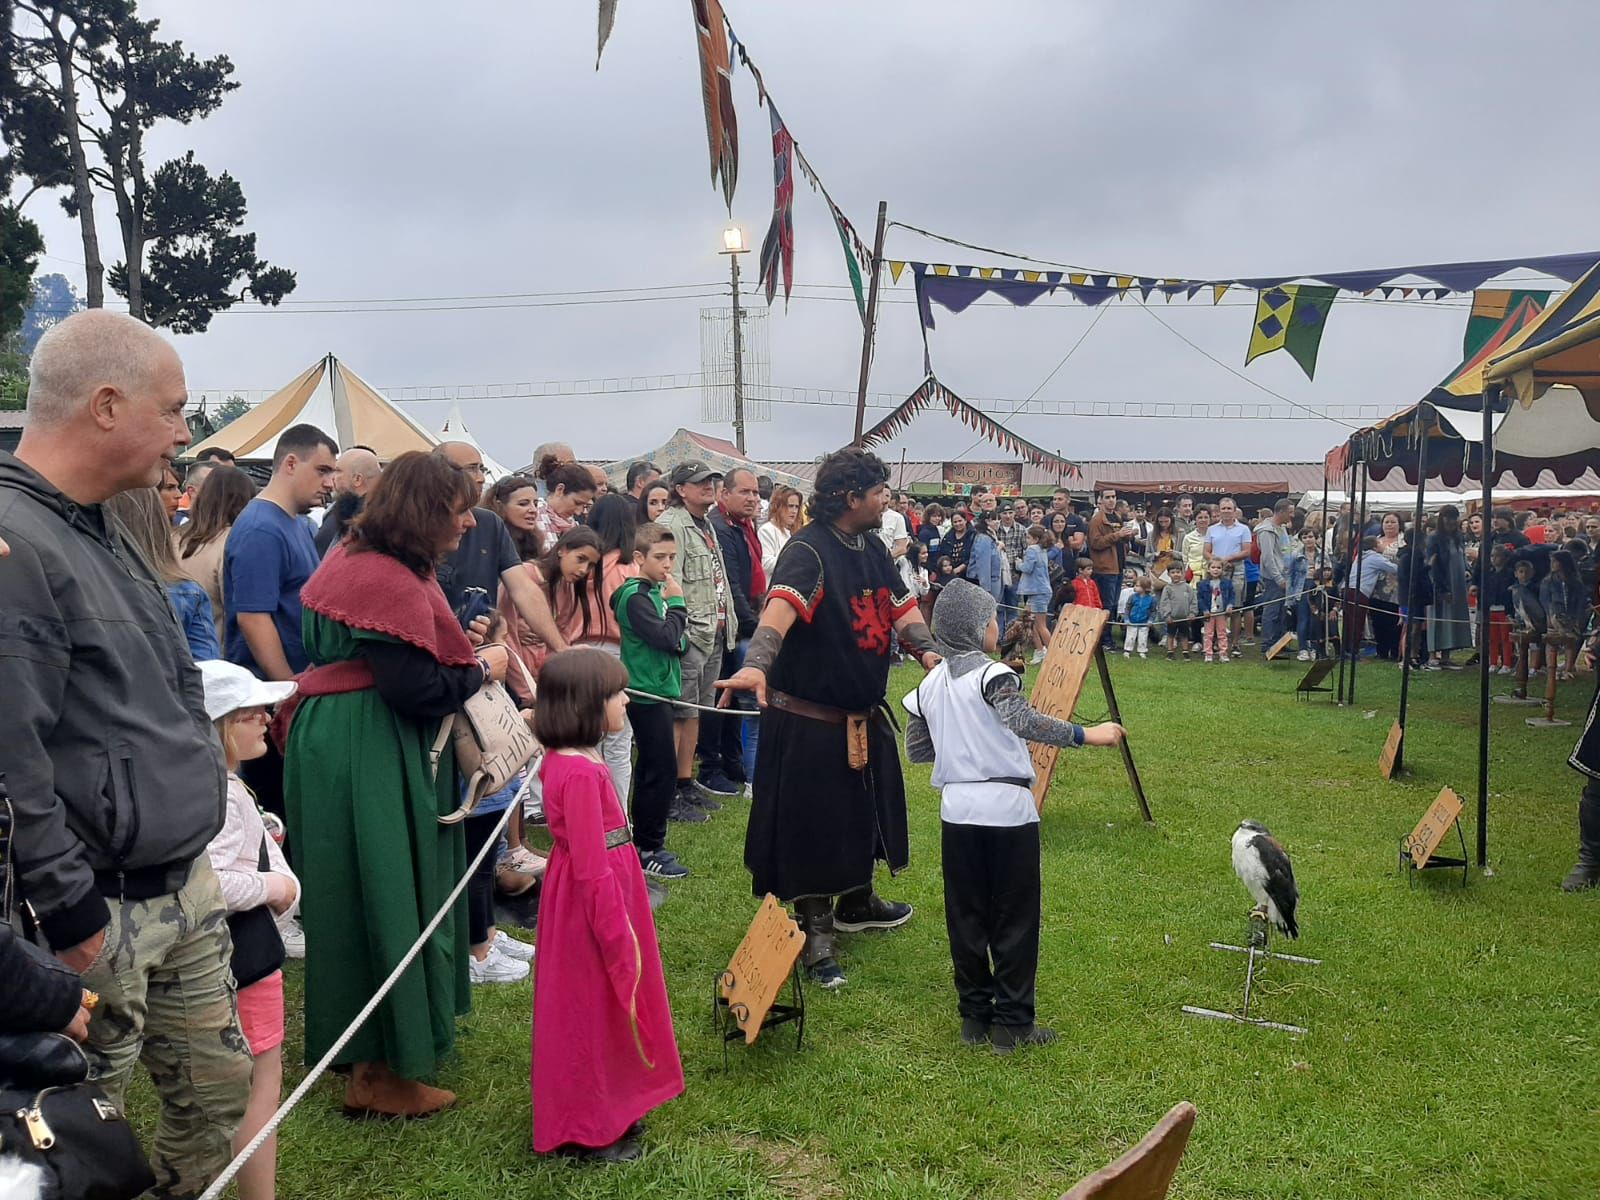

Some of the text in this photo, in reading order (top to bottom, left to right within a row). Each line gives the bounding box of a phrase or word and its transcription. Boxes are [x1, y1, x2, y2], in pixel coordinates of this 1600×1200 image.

[953, 464, 1015, 481] Mojitos
[1053, 617, 1094, 655] FOTOS
[1047, 664, 1068, 688] CON
